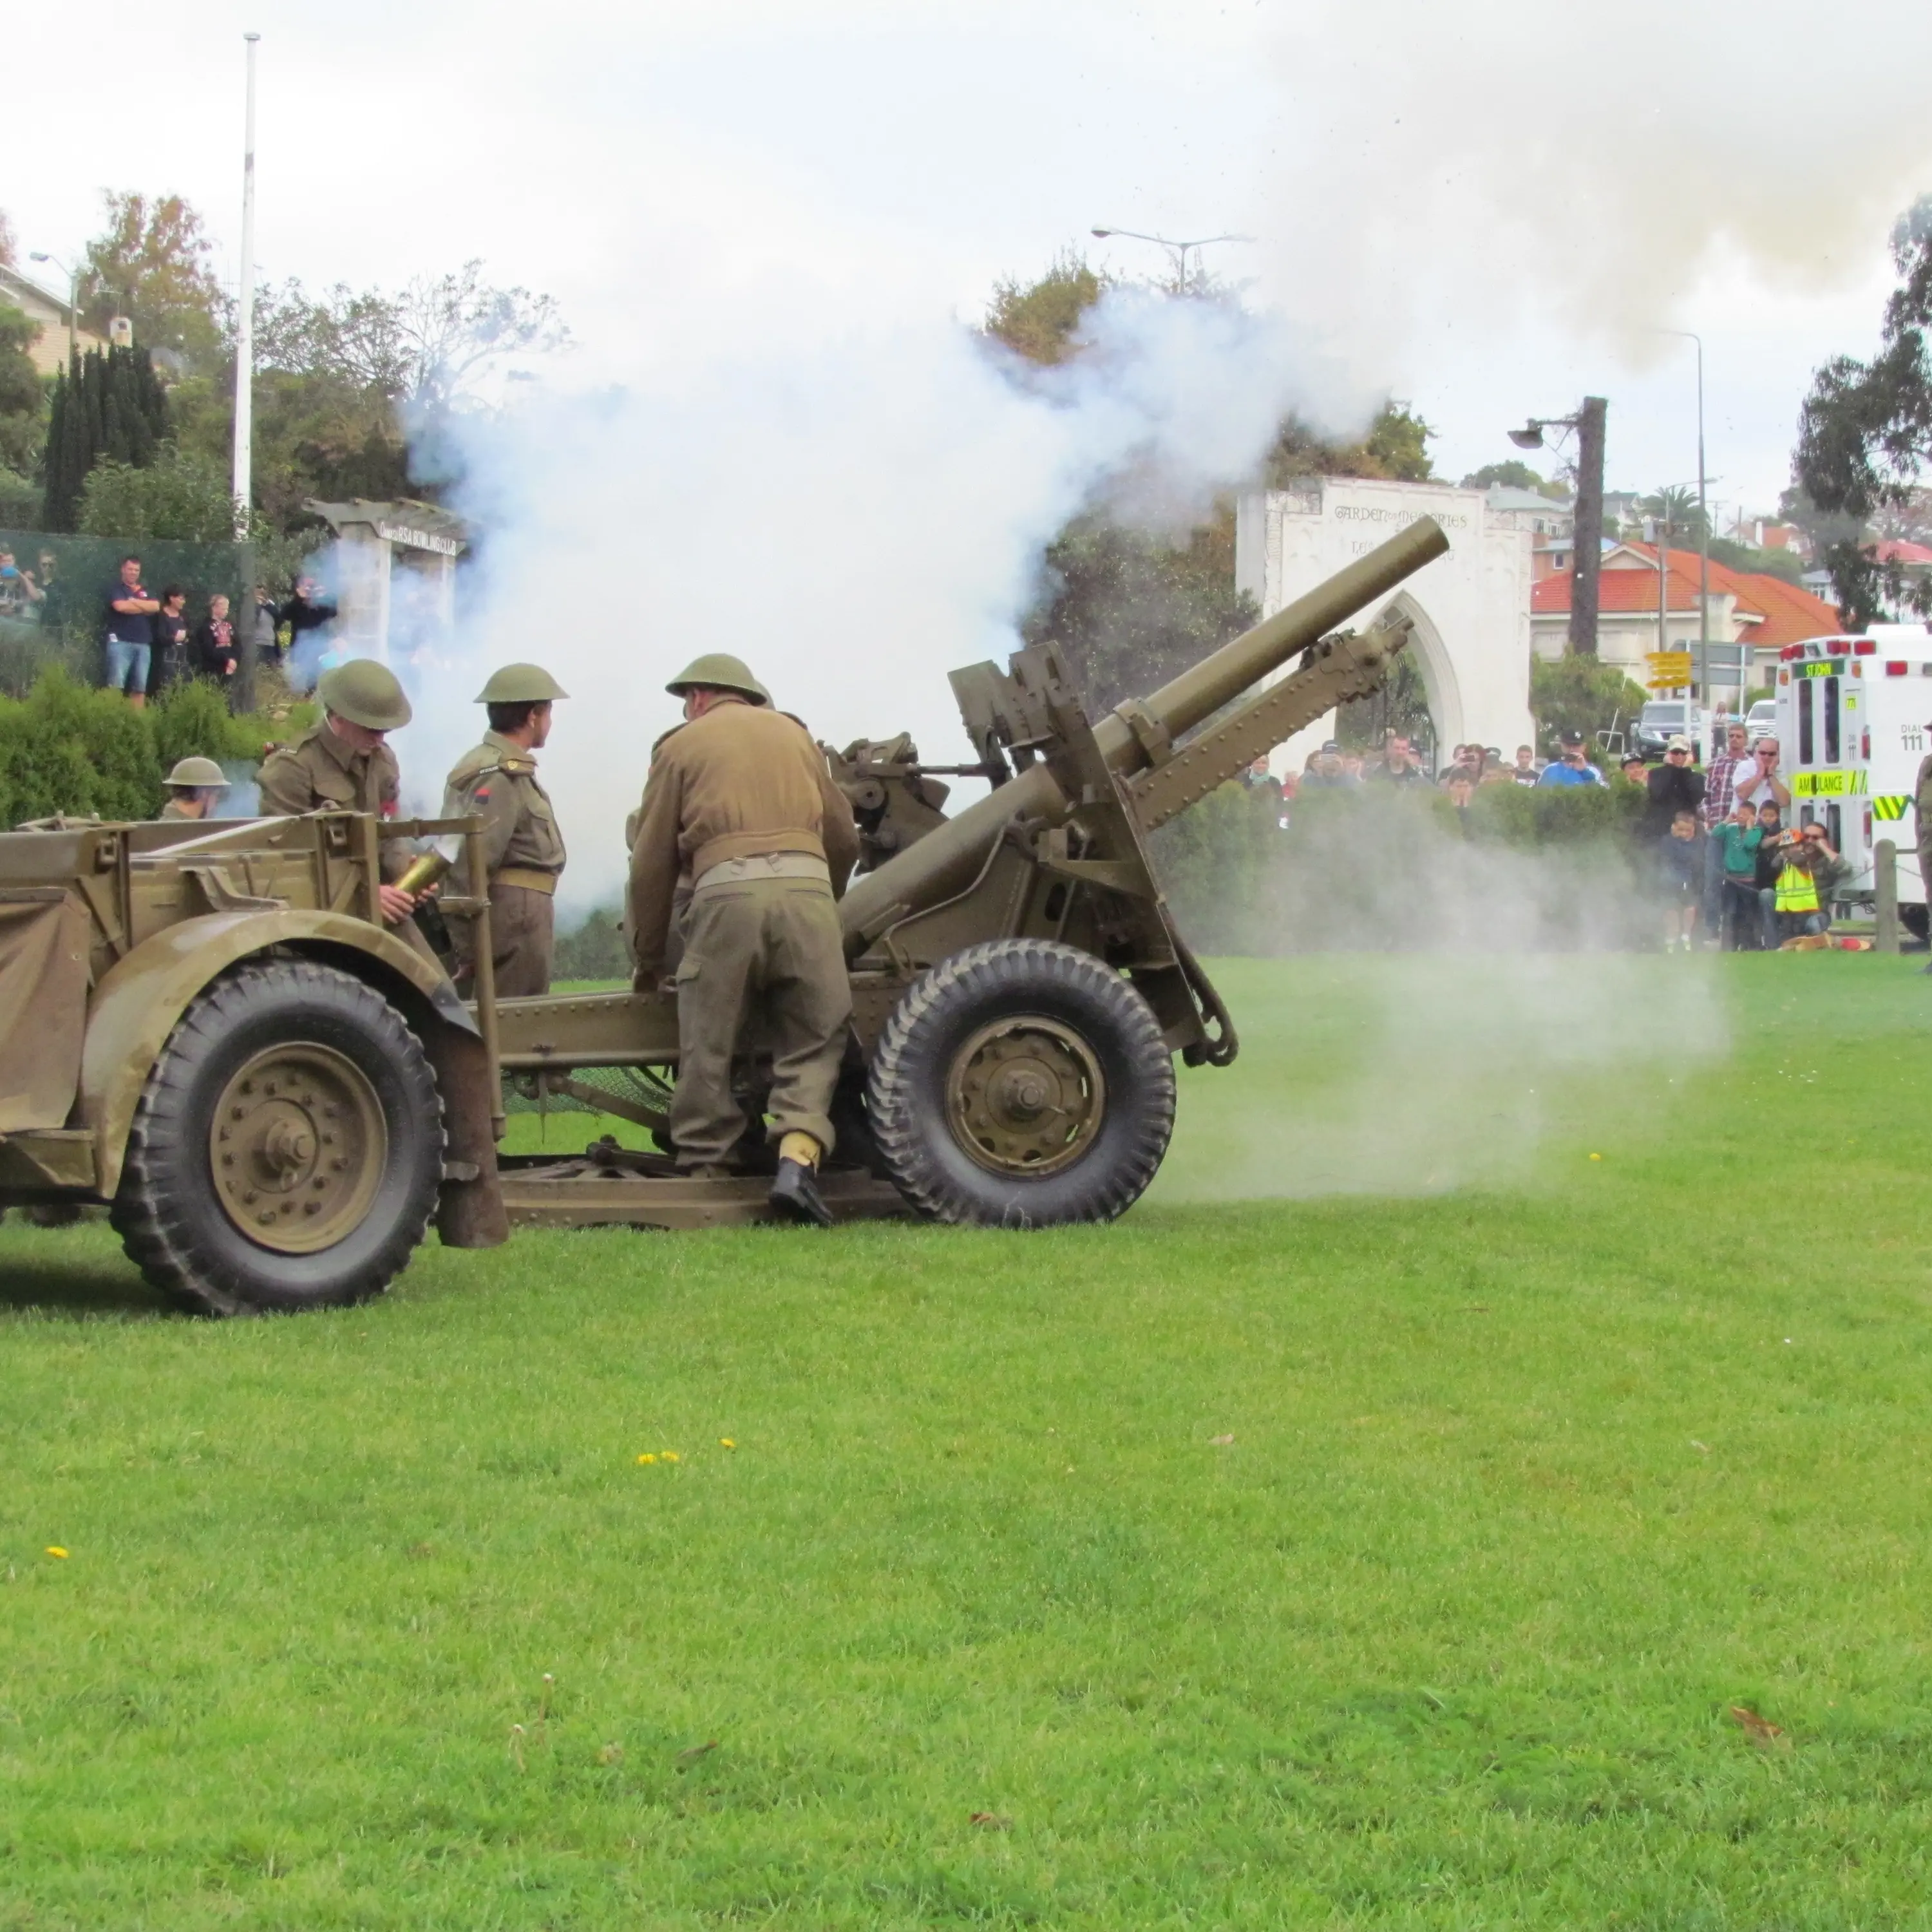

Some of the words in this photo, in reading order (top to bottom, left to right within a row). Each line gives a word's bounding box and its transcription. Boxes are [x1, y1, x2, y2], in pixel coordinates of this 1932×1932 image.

[1334, 506, 1388, 523] GARDEN
[1397, 510, 1468, 528] MEORIES
[399, 525, 413, 545] RSA
[413, 529, 440, 552] BOWLING
[440, 537, 457, 556] CLUB
[1901, 724, 1924, 733] DIAL
[1901, 734, 1922, 750] 111
[1799, 775, 1842, 793] AMULANCE
